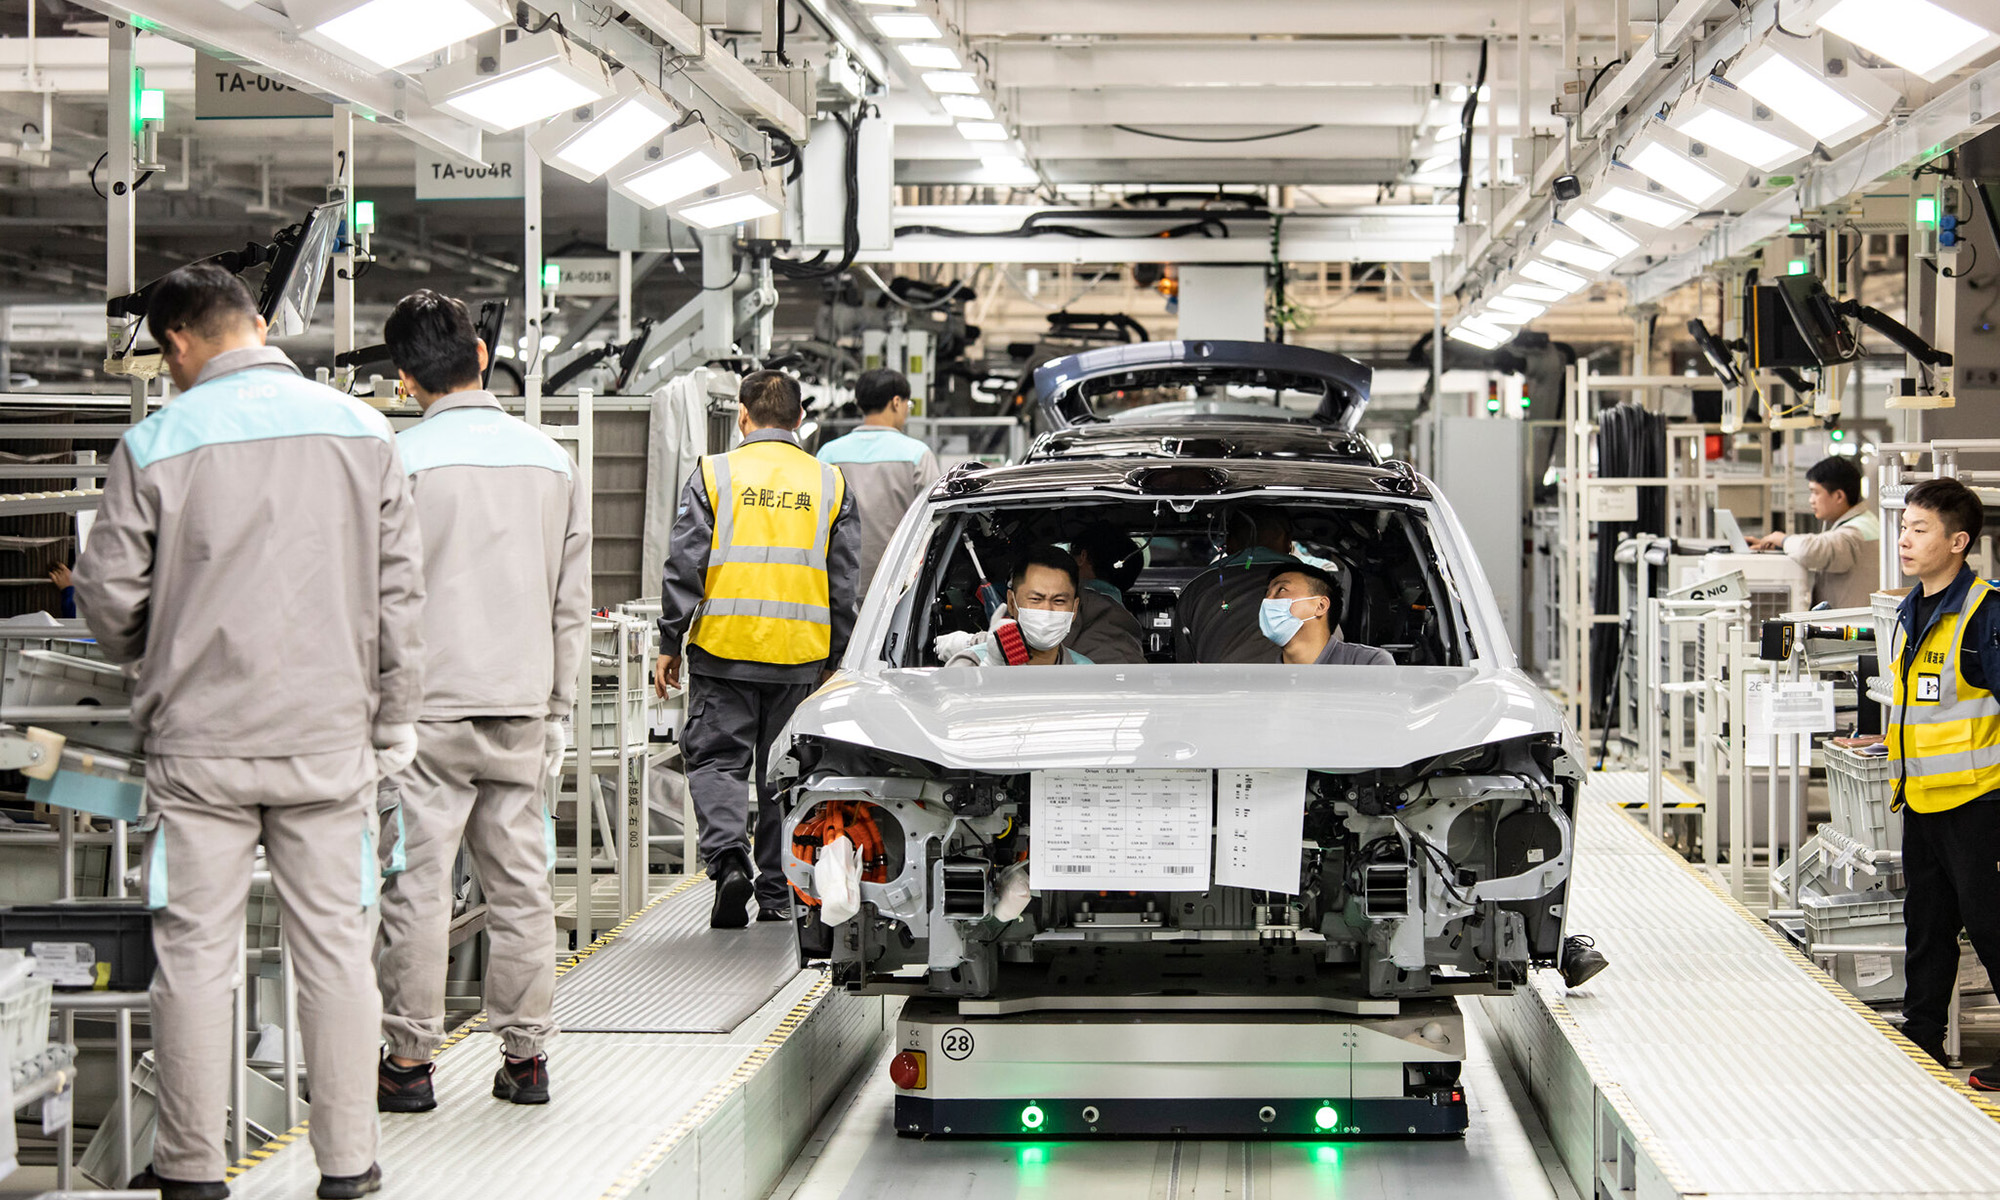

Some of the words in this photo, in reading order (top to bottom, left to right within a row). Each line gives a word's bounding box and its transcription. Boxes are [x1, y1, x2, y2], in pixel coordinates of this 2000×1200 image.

[215, 73, 297, 92] TA-00
[432, 163, 512, 179] TA-004R
[238, 384, 278, 400] NIO
[741, 486, 812, 511] 合肥汇典
[1706, 584, 1728, 597] NIO
[629, 831, 639, 848] 003
[945, 1035, 970, 1052] 28
